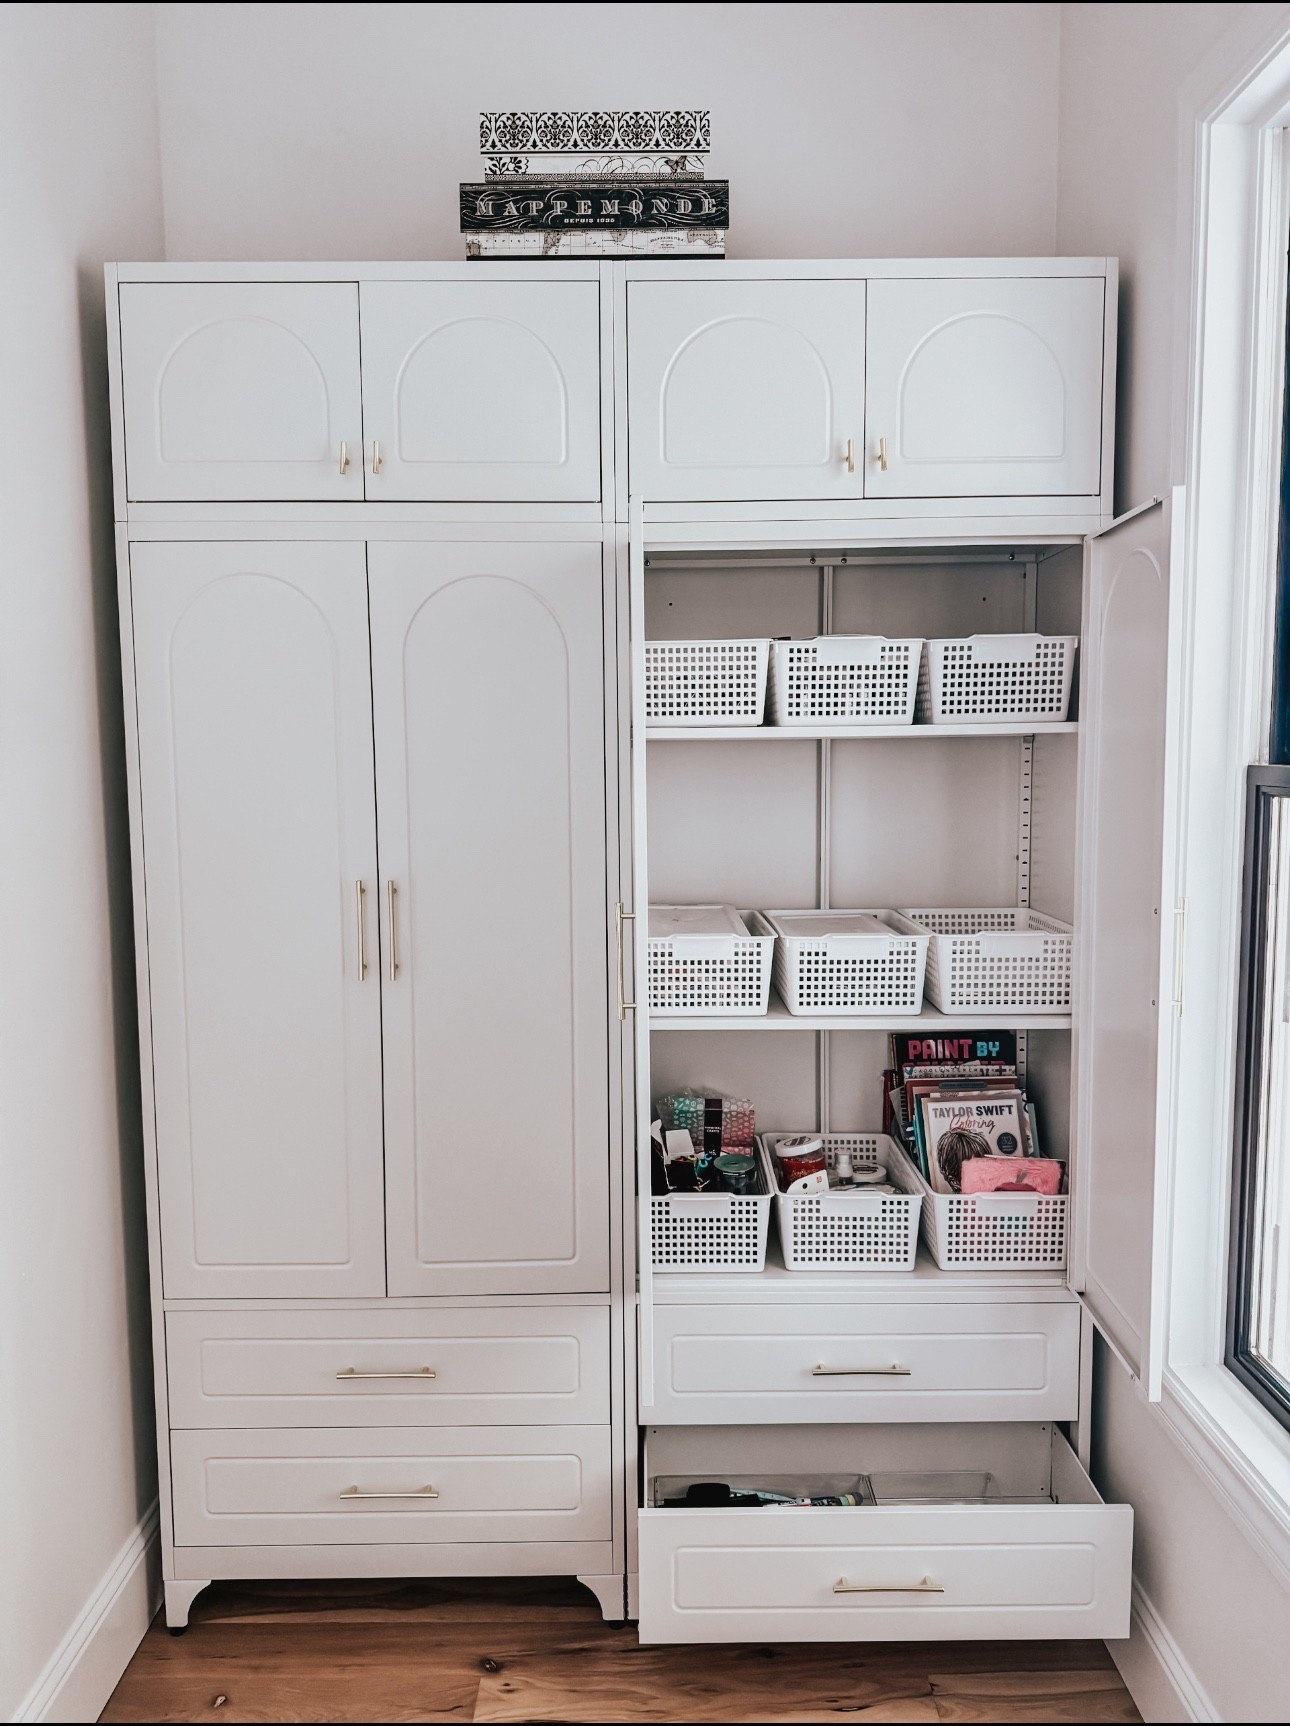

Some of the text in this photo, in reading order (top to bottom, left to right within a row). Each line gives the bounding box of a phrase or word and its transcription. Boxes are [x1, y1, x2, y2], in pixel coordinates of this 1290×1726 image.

[475, 198, 717, 216] MAPPEMONDE
[907, 1039, 1000, 1060] PAINT BY
[932, 1104, 1014, 1118] TAYLOR SWIFT
[950, 1114, 996, 1134] Coloring
